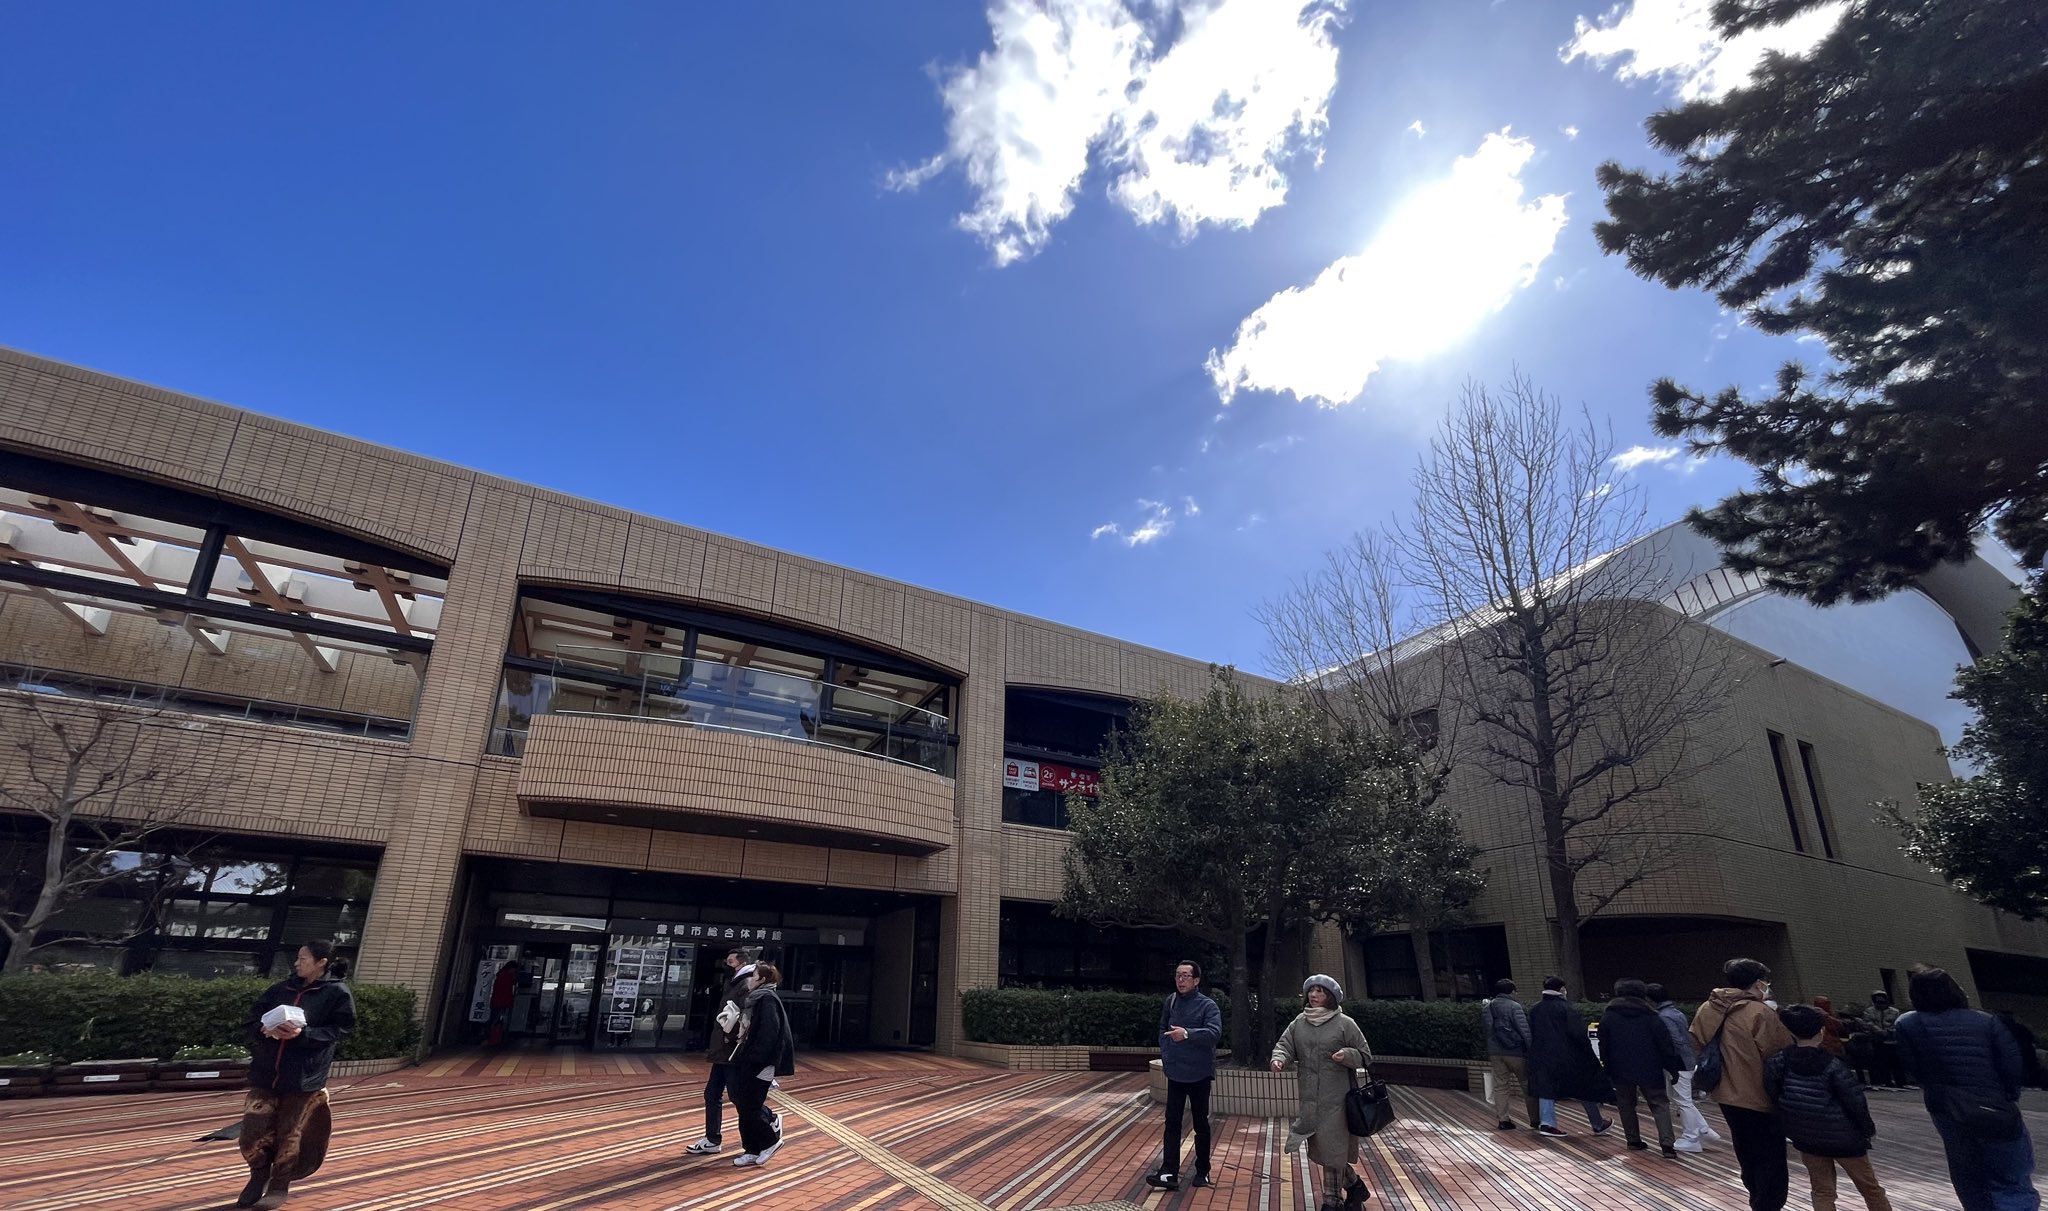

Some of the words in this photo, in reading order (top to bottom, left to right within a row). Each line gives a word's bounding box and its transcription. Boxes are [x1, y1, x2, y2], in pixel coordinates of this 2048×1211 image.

[1043, 769, 1054, 779] 2F
[656, 923, 783, 941] 豊橋市総合体育館
